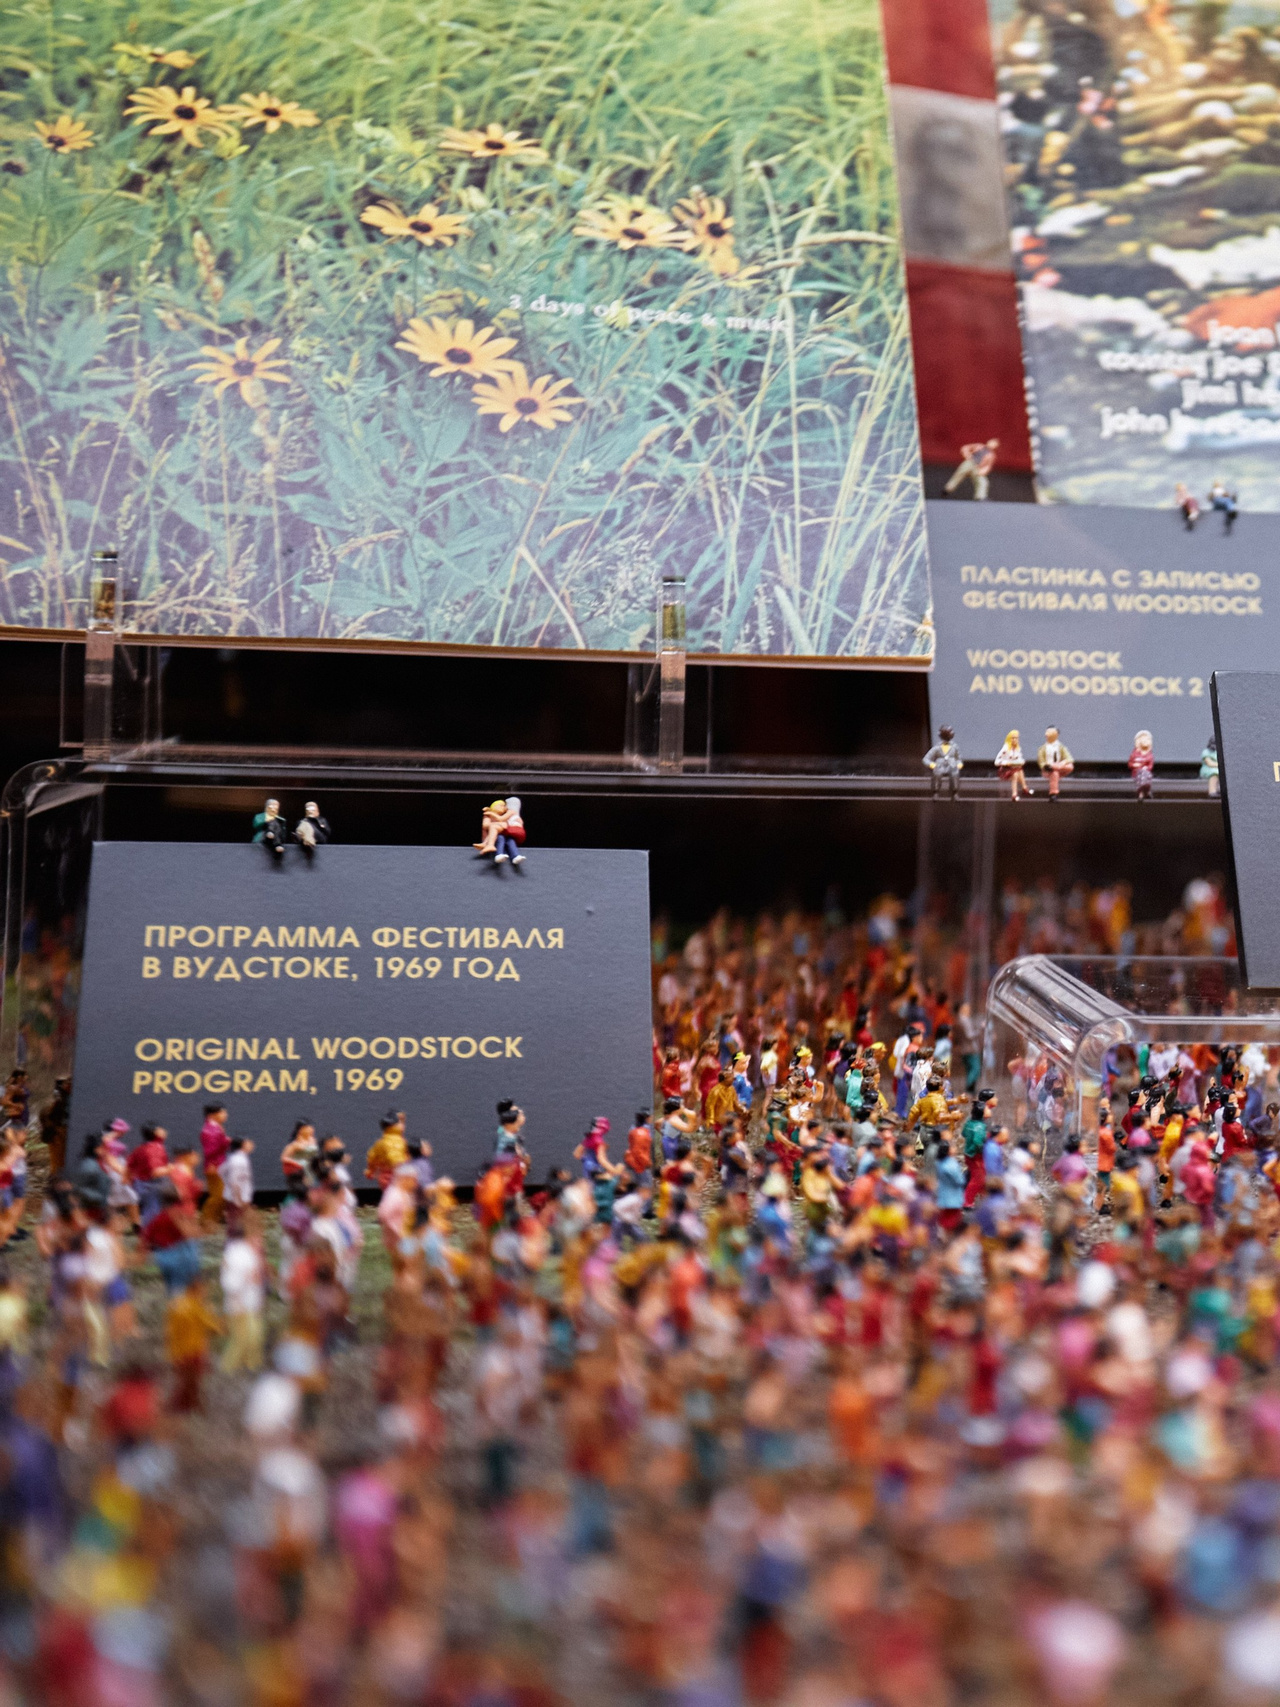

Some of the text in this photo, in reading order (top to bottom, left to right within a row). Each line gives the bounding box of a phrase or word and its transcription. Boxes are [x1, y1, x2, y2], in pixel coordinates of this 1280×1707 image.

[508, 294, 522, 310] 3
[529, 294, 586, 318] days
[627, 307, 693, 327] peace
[726, 314, 788, 332] music
[1207, 319, 1276, 349] joan
[1213, 350, 1263, 379] joe
[1100, 407, 1168, 439] john
[960, 565, 1261, 592] ПЛАСТИНКА С ЗАПИСЬЮ
[962, 590, 1263, 616] ФЕСТИВАЛЯ WOODSTOCK
[967, 649, 1123, 670] WOODSTOCK
[970, 674, 1204, 697] AND WOODSTOCK 2
[143, 924, 565, 950] ПРОГРАММА ФЕСТИВАЛЯ
[141, 955, 521, 982] В ВУДСТОКЕ, 1969 ГОД
[134, 1035, 523, 1062] ORIGINAL WOODSTOCK
[132, 1067, 404, 1095] PROGRAM, 1969
